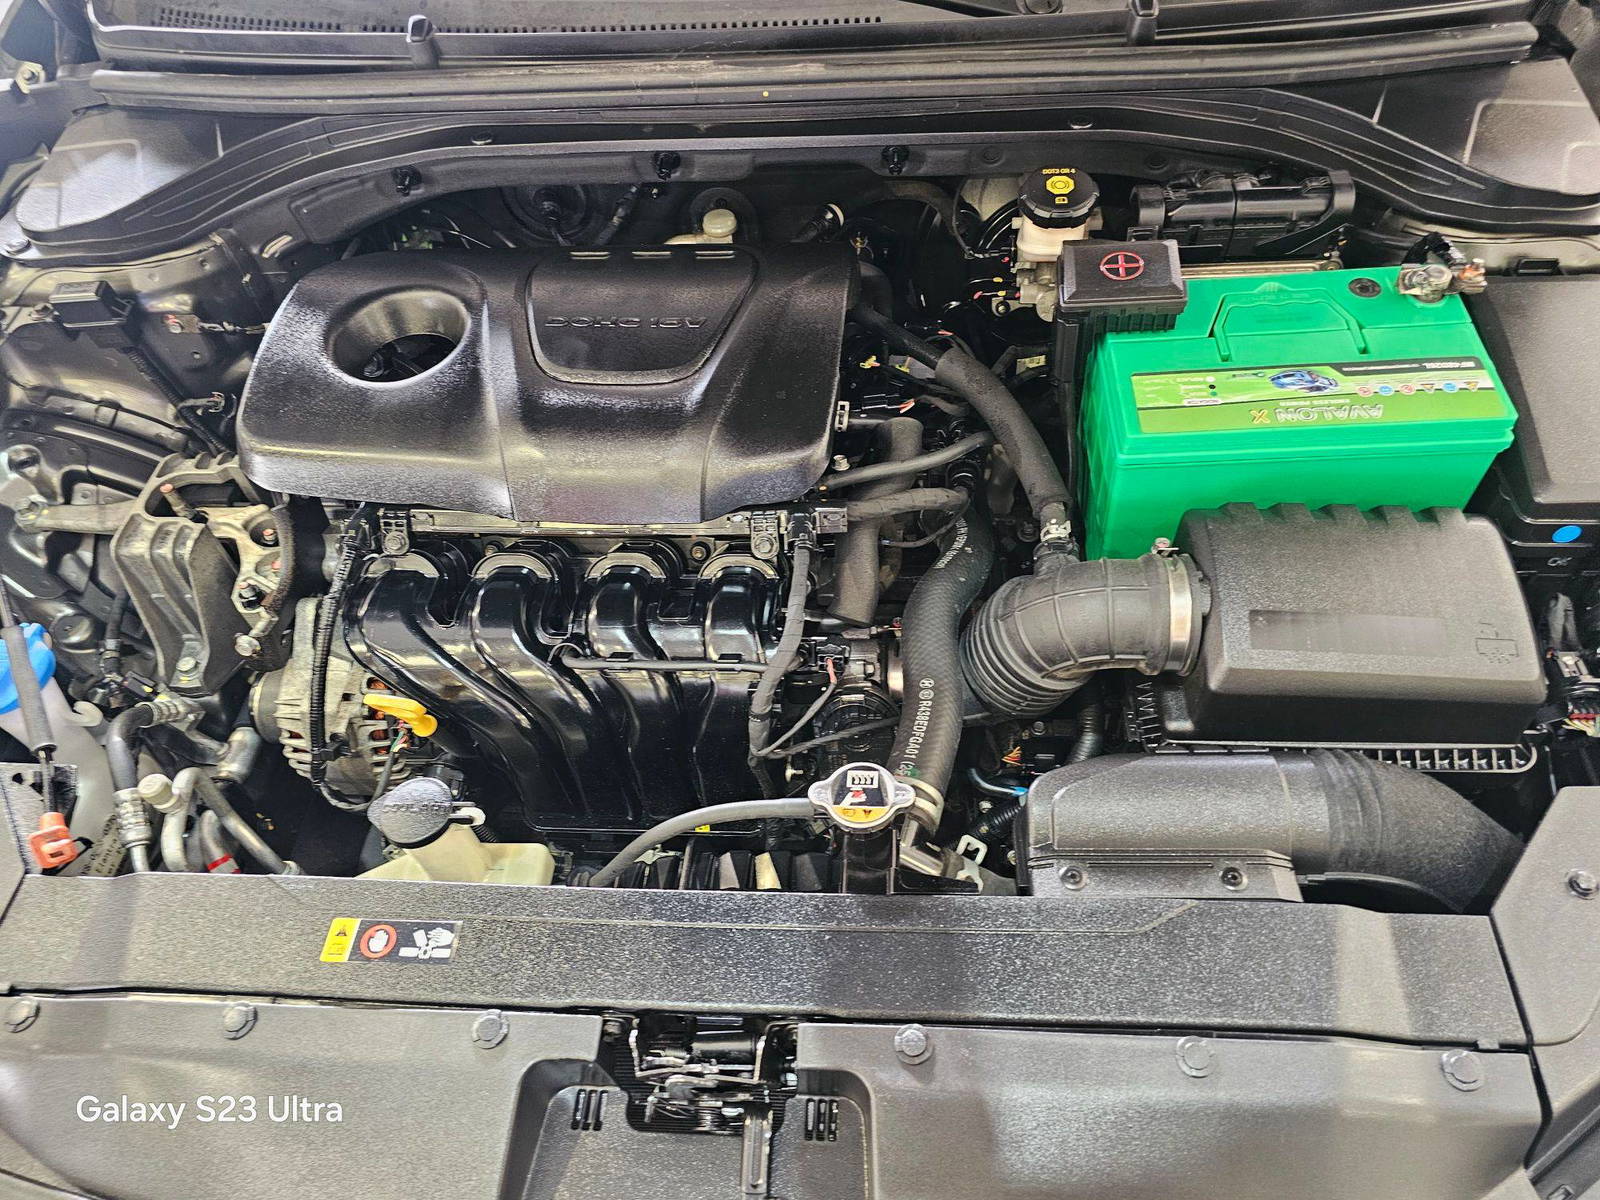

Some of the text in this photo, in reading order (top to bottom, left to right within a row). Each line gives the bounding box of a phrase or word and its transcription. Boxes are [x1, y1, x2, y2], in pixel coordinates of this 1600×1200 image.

[545, 316, 641, 328] DOHC
[1251, 404, 1384, 424] AVALON X
